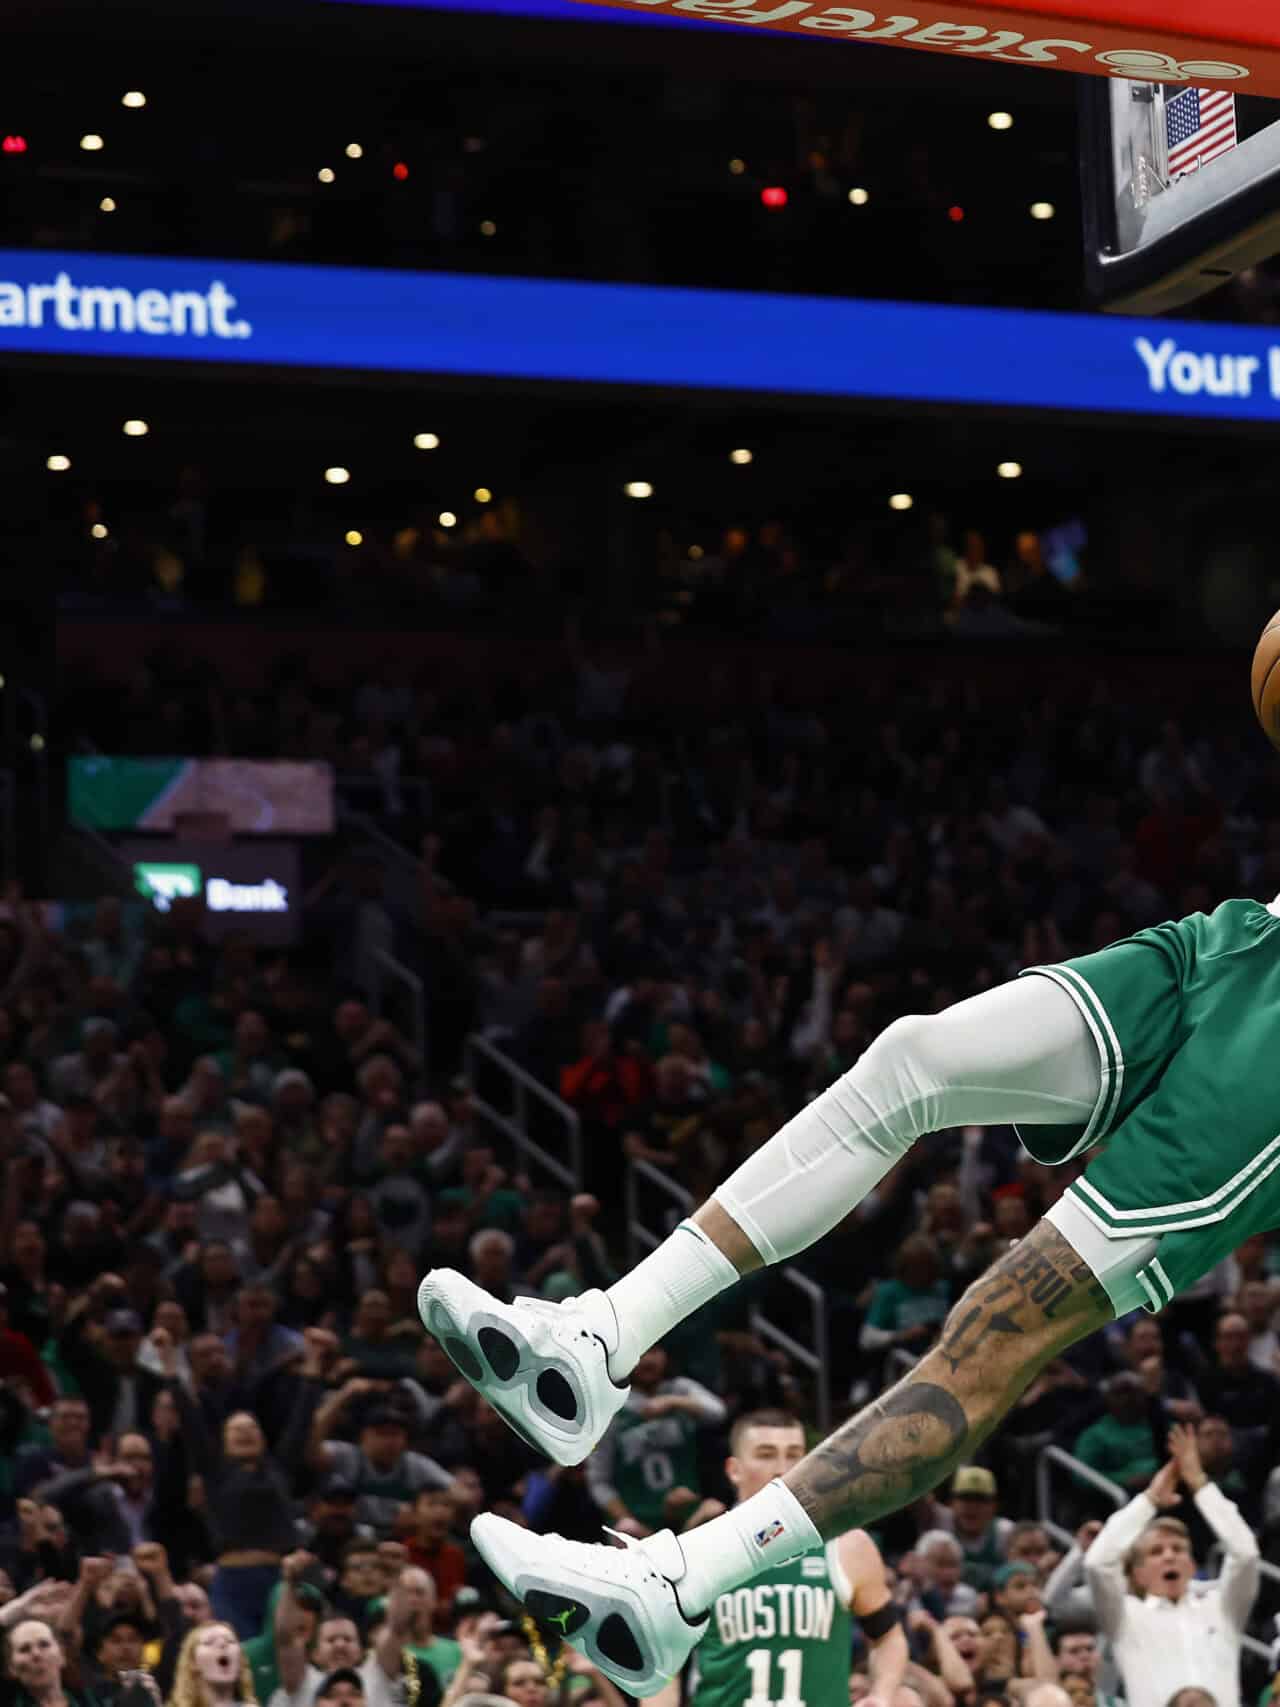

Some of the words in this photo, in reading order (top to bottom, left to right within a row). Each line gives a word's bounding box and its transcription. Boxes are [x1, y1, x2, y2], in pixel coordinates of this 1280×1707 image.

[634, 0, 815, 24] Fa
[0, 272, 252, 339] artment.
[1134, 336, 1259, 397] Your
[715, 1583, 836, 1646] BOSTON
[743, 1648, 807, 1707] 11
